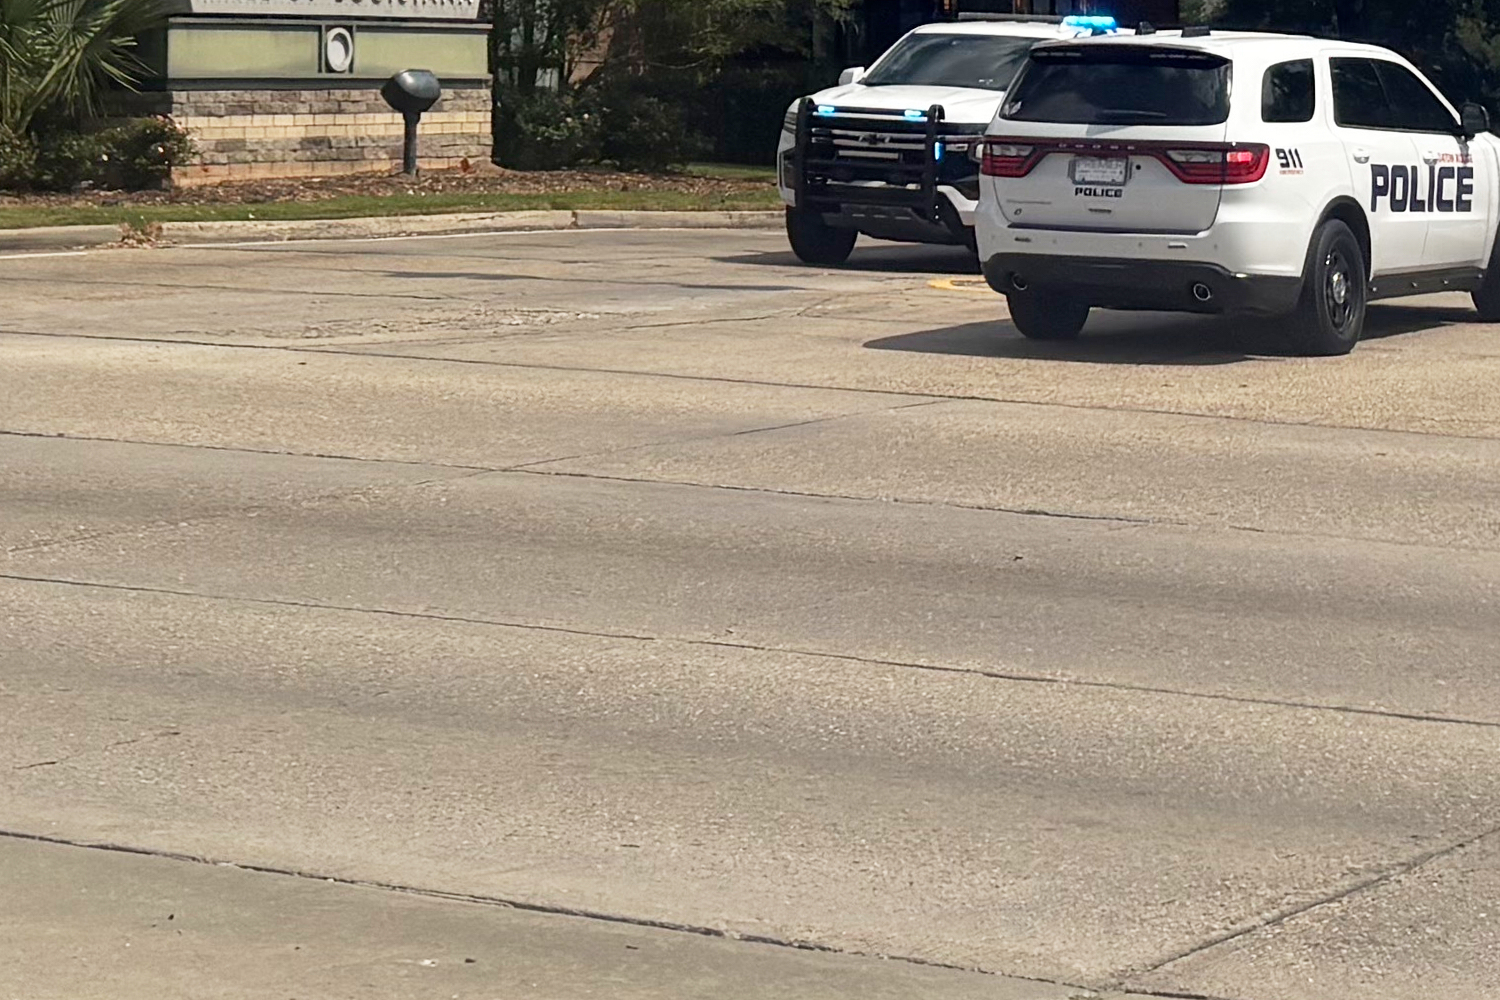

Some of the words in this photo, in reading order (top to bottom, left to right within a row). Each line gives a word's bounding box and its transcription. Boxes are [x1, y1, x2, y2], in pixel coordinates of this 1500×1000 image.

[1275, 148, 1303, 168] 911
[1075, 187, 1123, 198] POLICE
[1370, 163, 1474, 213] POLICE
